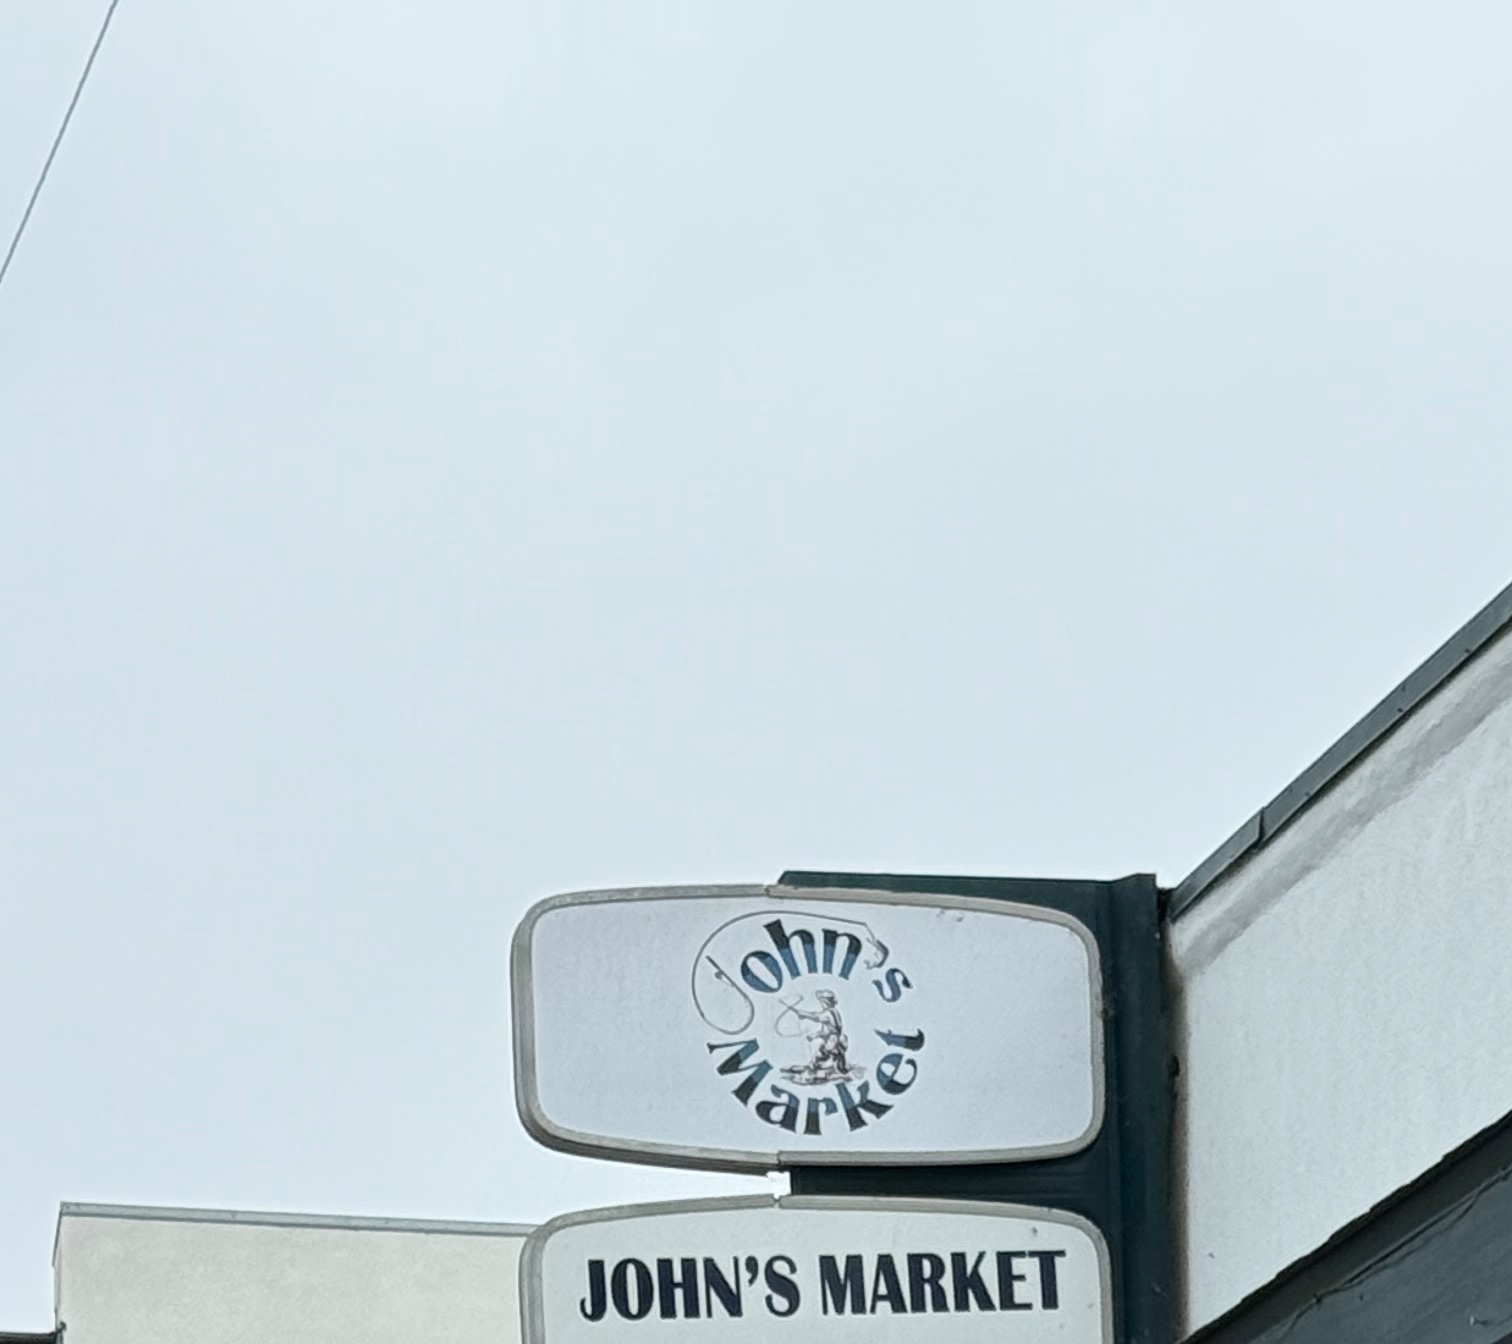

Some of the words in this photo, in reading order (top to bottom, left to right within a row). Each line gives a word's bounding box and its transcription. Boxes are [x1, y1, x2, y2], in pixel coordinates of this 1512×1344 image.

[691, 910, 914, 1035] John's
[707, 1025, 926, 1135] Market
[580, 1254, 799, 1322] JOHN'S
[819, 1249, 1067, 1316] MARKET
